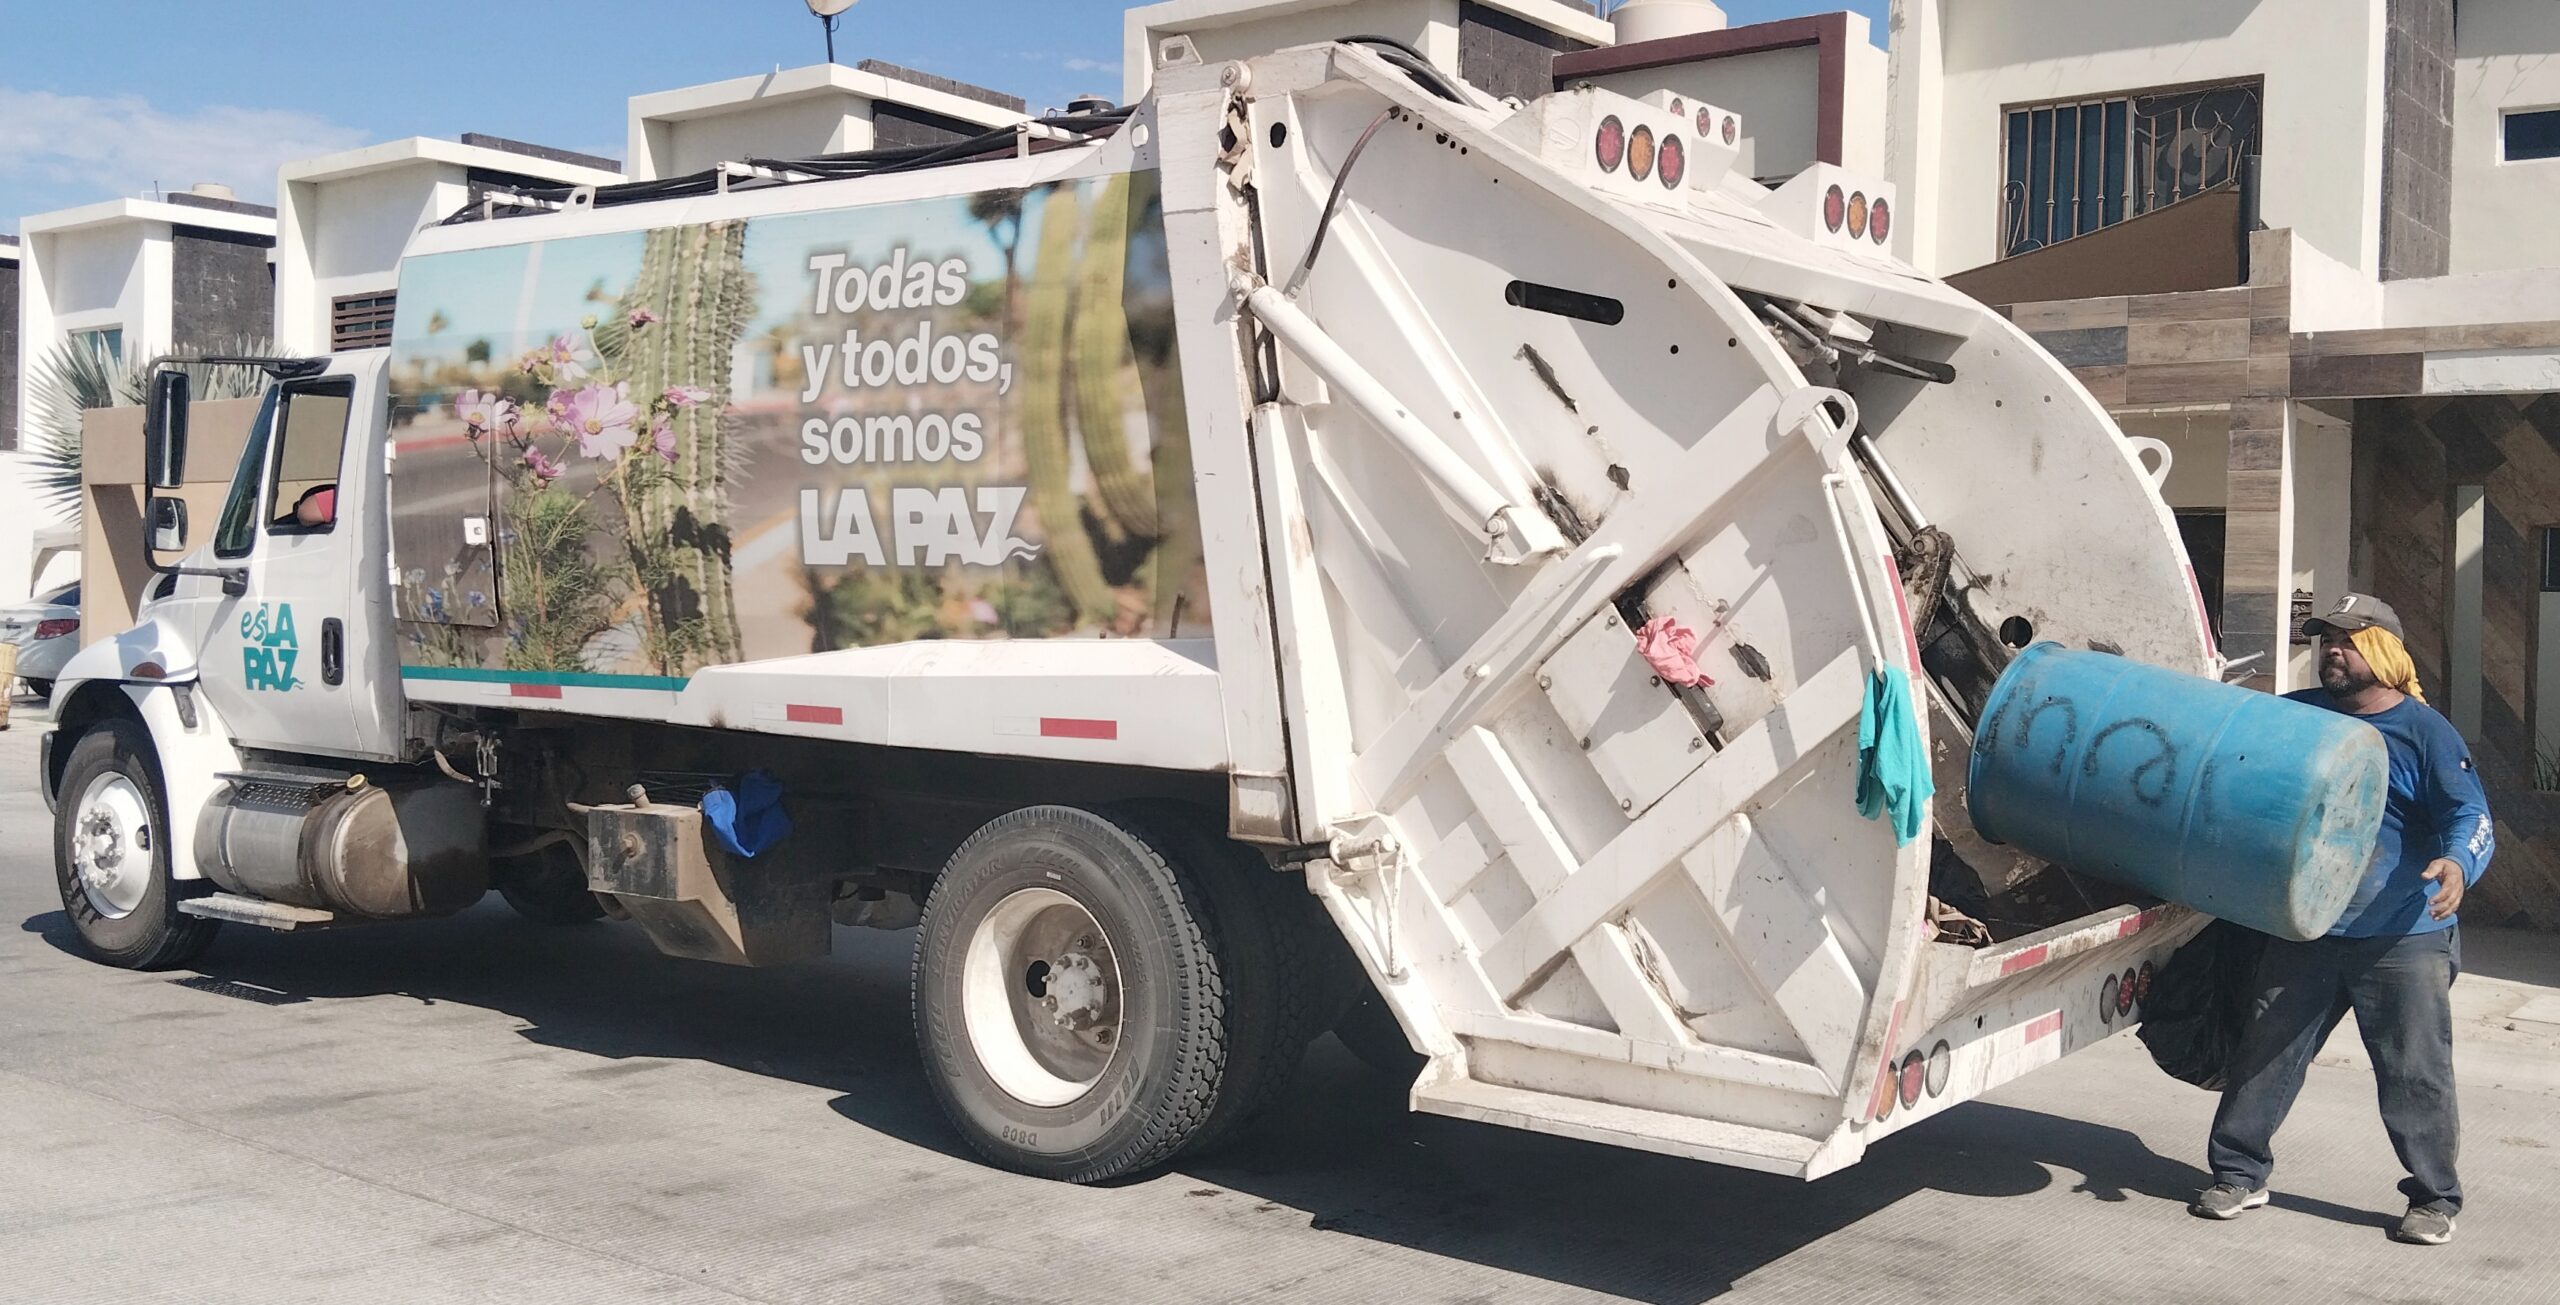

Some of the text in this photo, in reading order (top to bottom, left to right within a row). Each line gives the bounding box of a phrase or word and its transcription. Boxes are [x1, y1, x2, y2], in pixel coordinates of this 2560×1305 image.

[809, 247, 967, 314] Todas
[802, 320, 1012, 403] y todos,
[801, 412, 983, 464] somos
[800, 486, 1028, 566] LA PAZ
[243, 647, 299, 692] PAZ
[1002, 1125, 1037, 1146] D808
